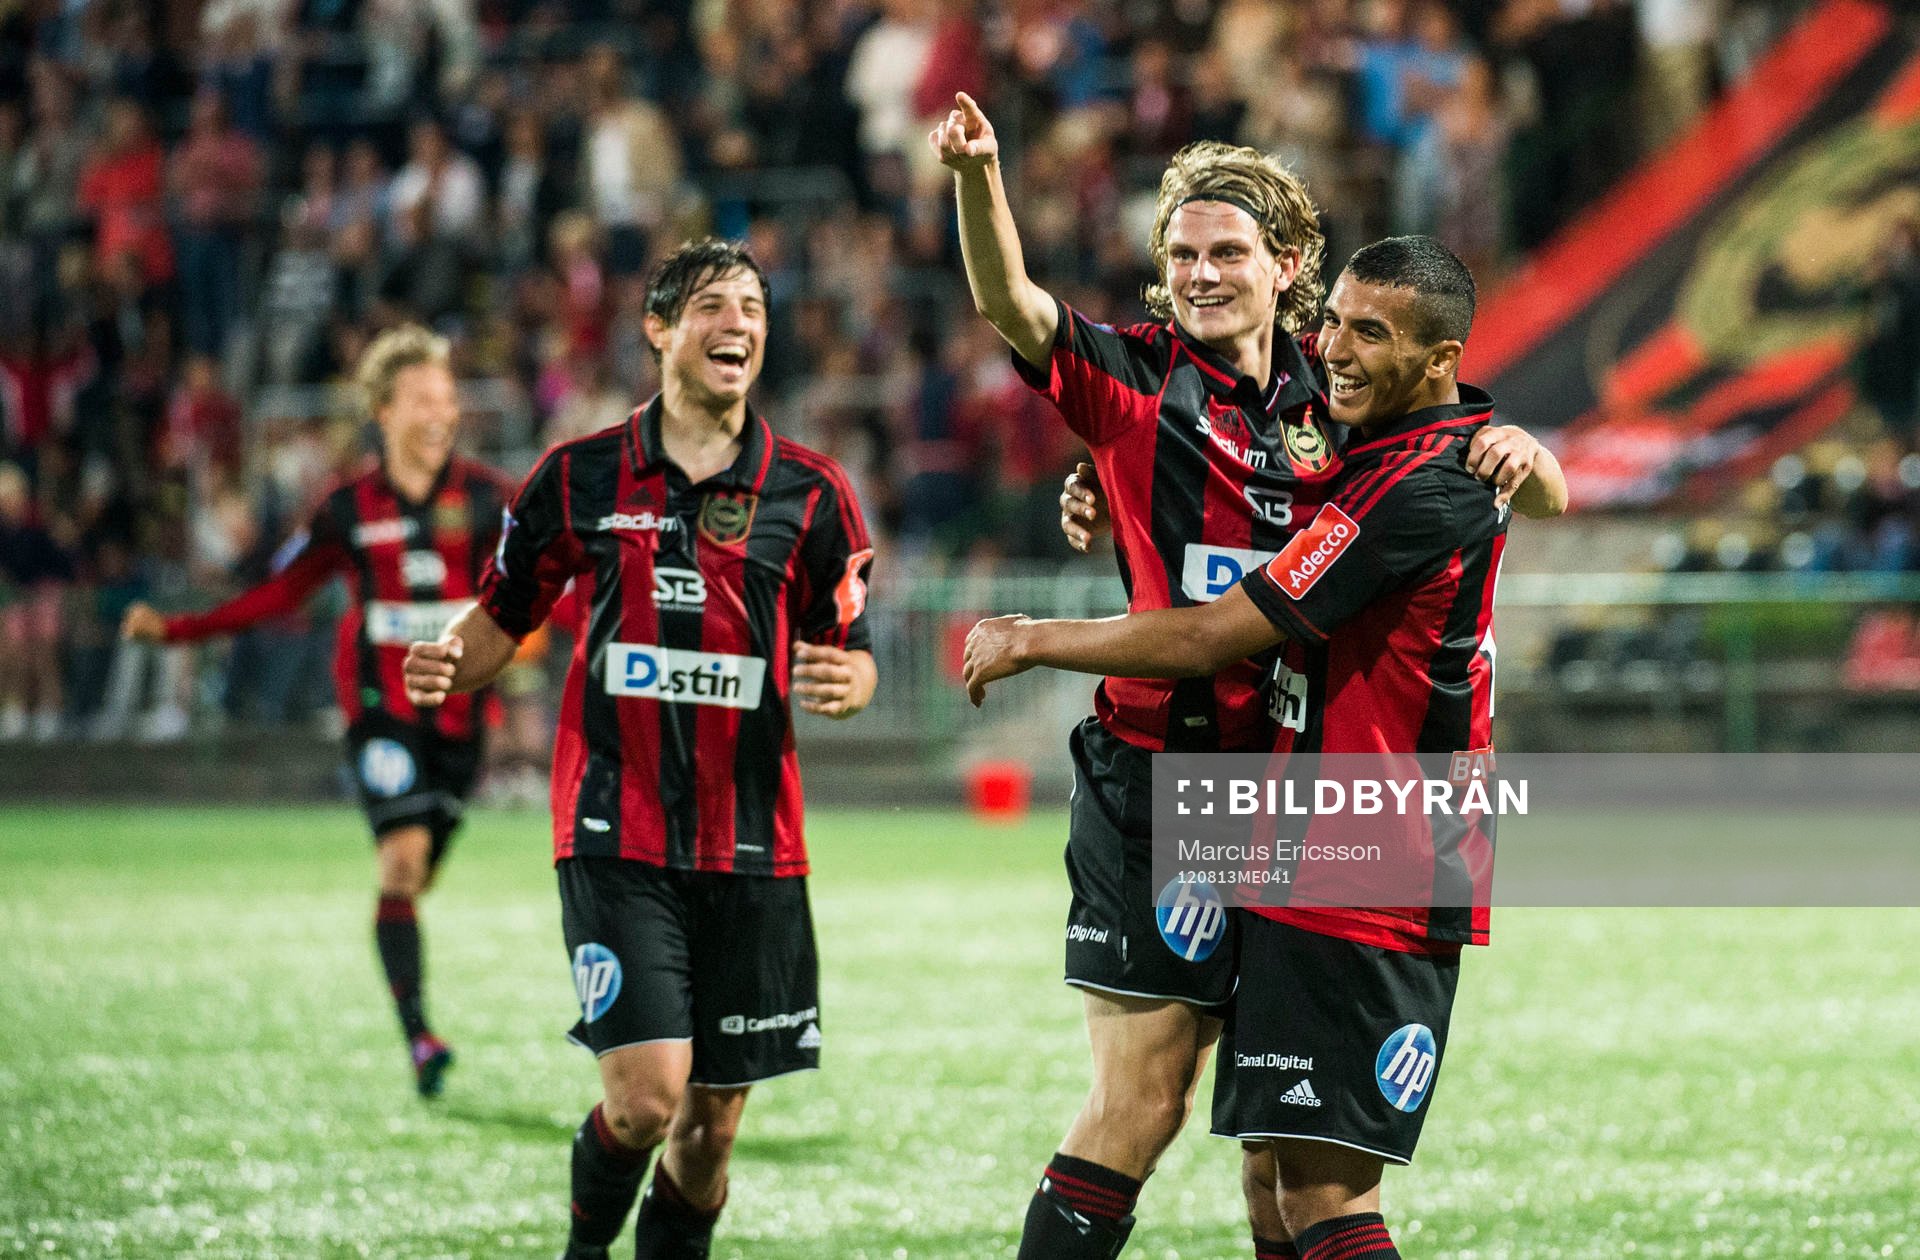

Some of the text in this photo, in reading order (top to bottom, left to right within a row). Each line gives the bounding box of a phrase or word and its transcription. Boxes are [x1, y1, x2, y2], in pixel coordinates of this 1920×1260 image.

[1289, 523, 1349, 589] Adecco
[1069, 924, 1109, 944] Digital
[1164, 875, 1224, 962] hp
[573, 944, 615, 1024] hp
[1237, 1053, 1314, 1071] Canal Digital
[1380, 1024, 1435, 1111] hp
[1280, 1094, 1322, 1107] adidas
